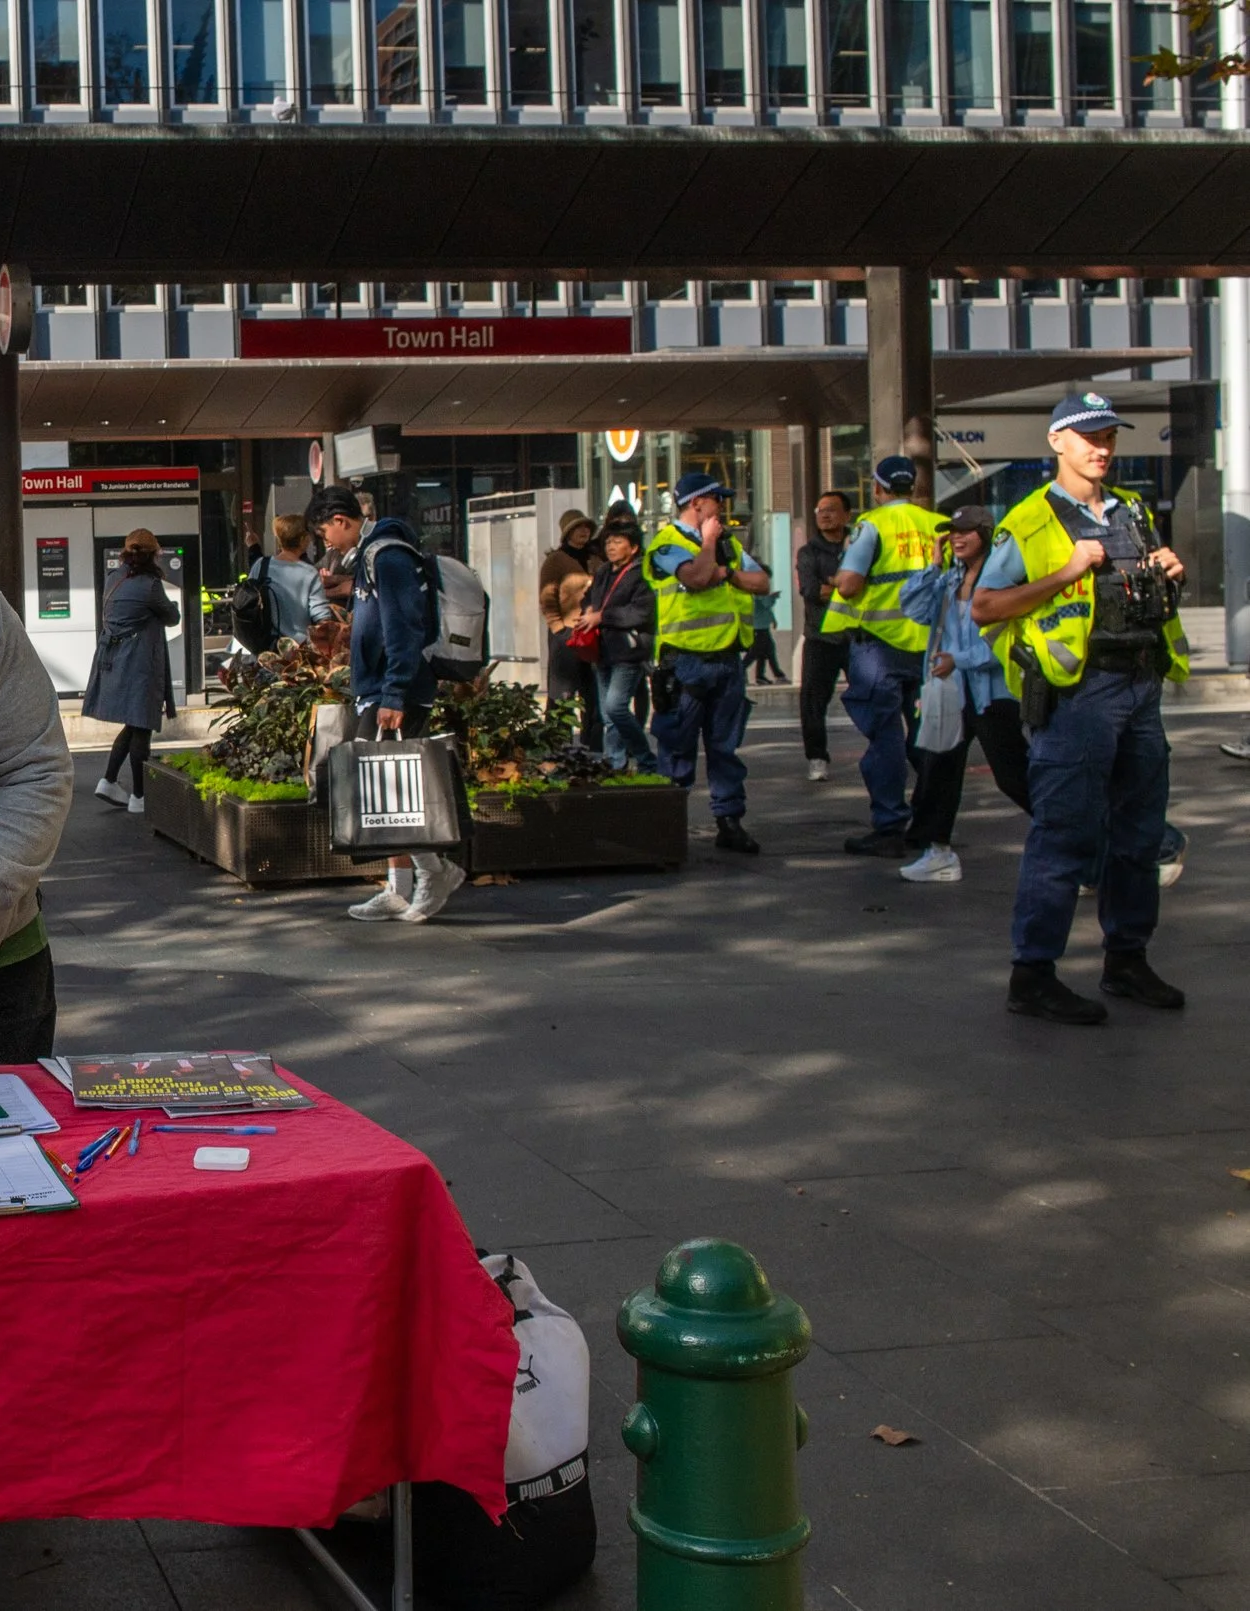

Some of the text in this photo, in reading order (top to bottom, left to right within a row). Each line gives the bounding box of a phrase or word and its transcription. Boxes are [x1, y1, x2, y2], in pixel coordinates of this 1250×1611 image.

[383, 325, 494, 348] Town Hall
[56, 475, 82, 489] Hall
[365, 815, 421, 825] Foot Locker
[119, 1077, 173, 1085] CHANGE
[516, 1379, 538, 1395] PUMA
[559, 1458, 586, 1486] PUMA
[519, 1475, 554, 1501] PUMA
